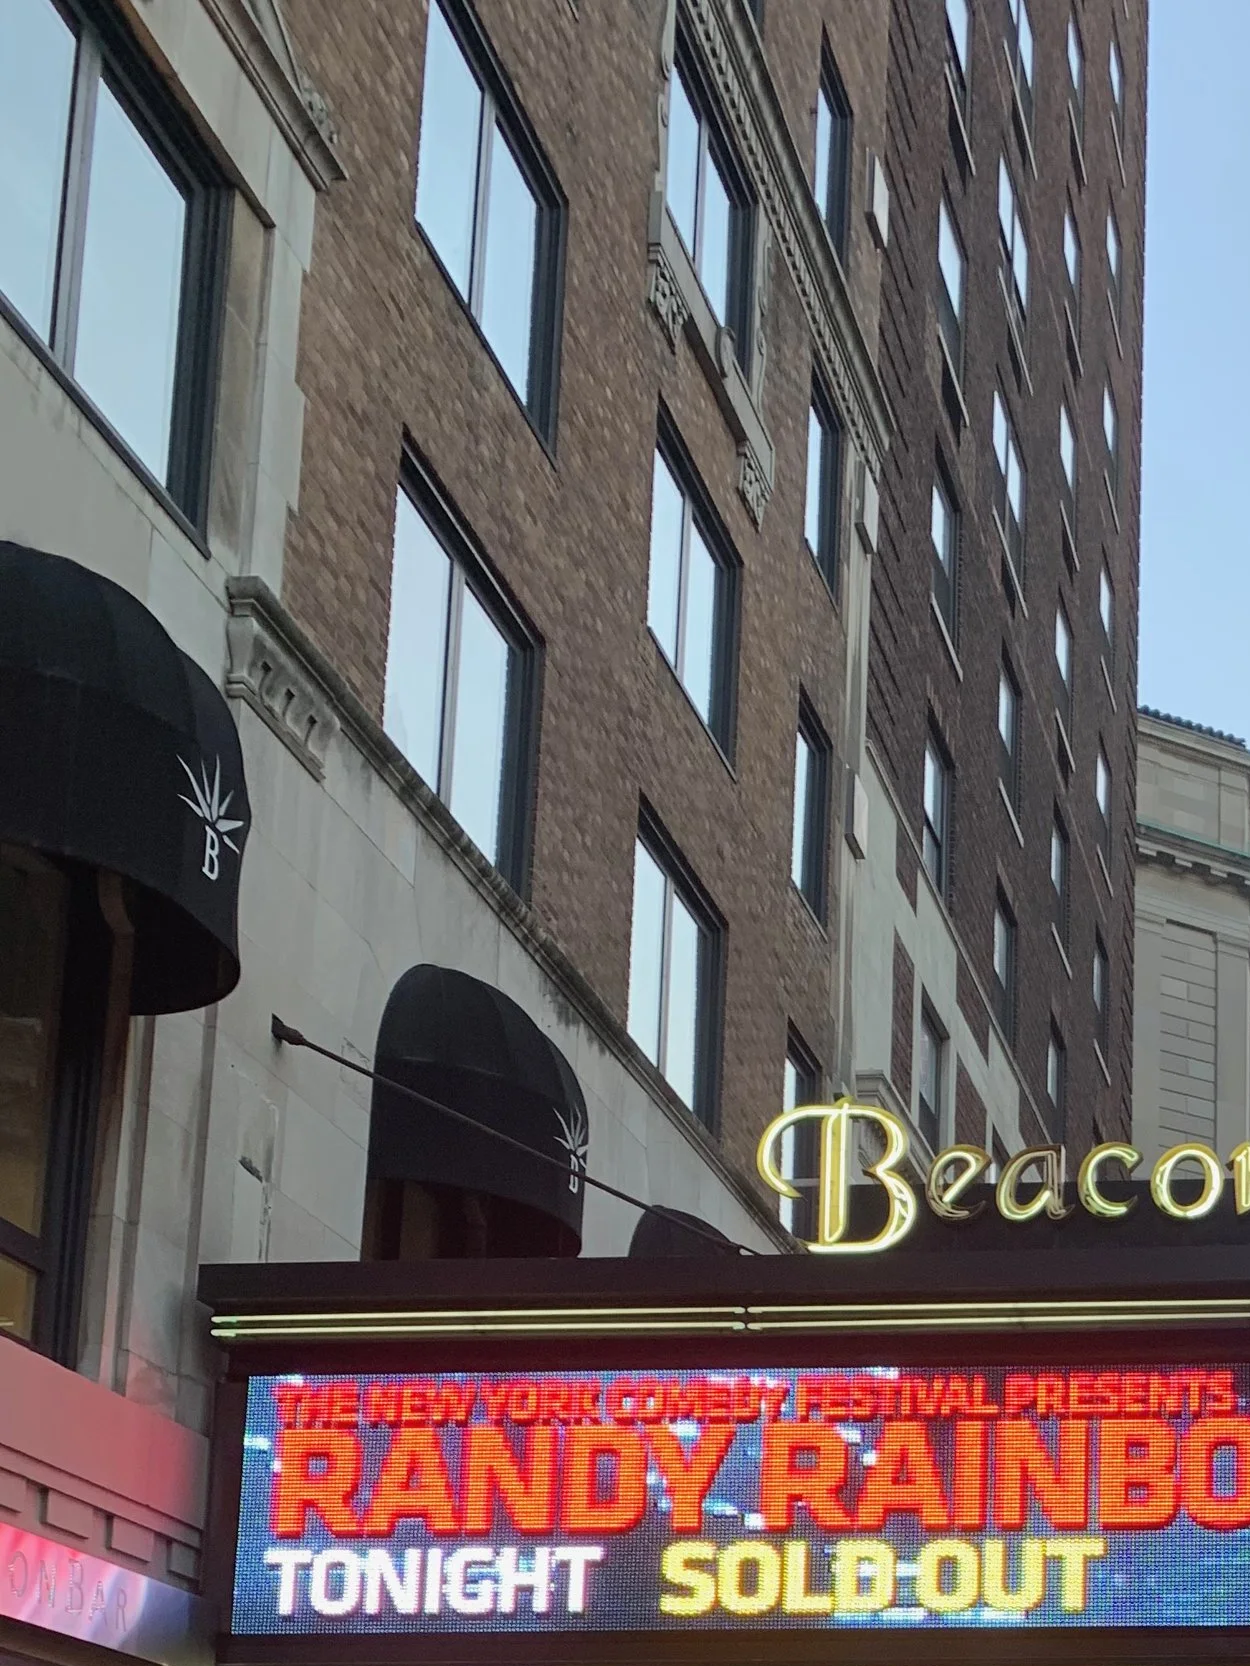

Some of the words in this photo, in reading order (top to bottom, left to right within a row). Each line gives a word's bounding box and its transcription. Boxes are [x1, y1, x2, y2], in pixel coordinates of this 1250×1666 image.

[275, 1382, 360, 1427] THE
[362, 1380, 475, 1425] NEW
[476, 1379, 603, 1424] YORK
[605, 1376, 792, 1424] COMEDY
[797, 1373, 1000, 1422] FESTIVAL
[1003, 1370, 1239, 1420] PRESENTS
[271, 1420, 737, 1540] RANDY
[264, 1546, 605, 1617] TONIGHT
[659, 1538, 897, 1616] SOLD
[917, 1537, 1108, 1615] OUT
